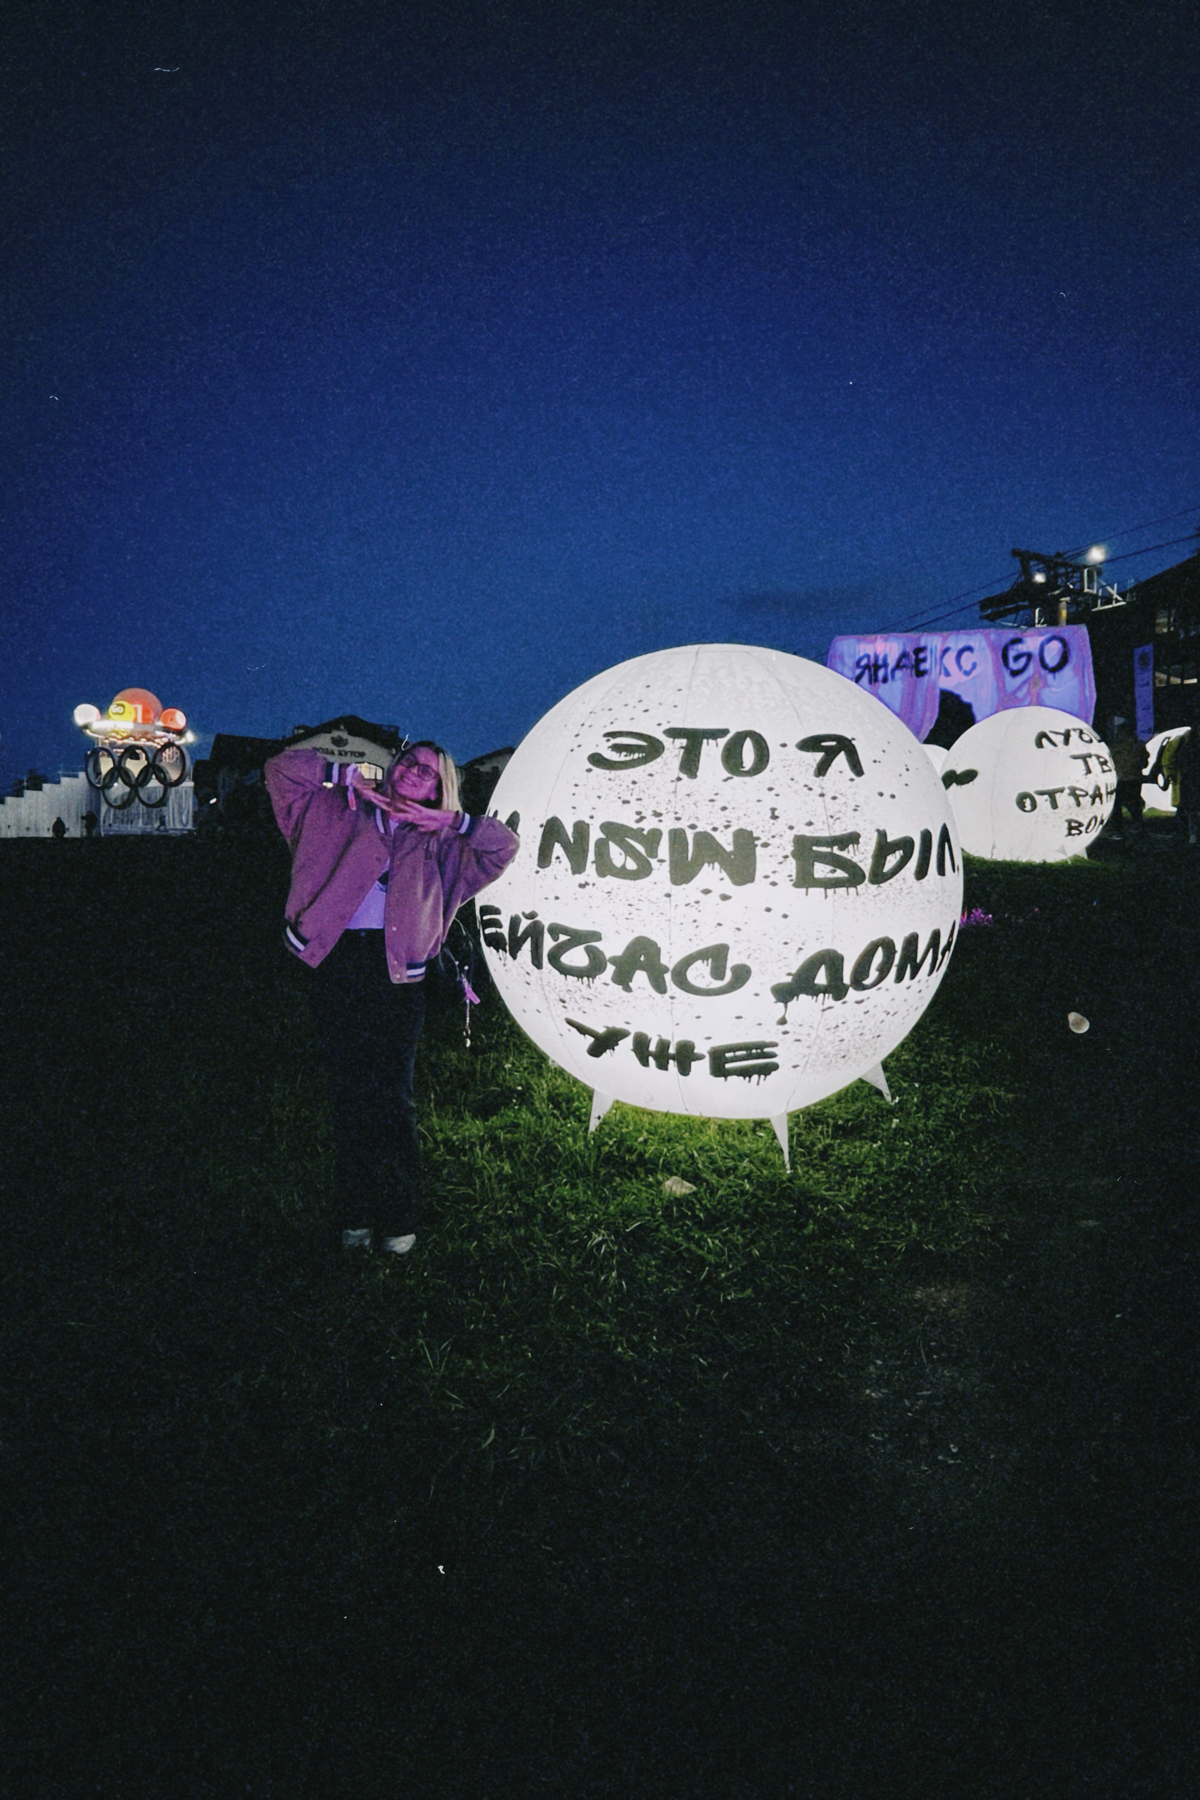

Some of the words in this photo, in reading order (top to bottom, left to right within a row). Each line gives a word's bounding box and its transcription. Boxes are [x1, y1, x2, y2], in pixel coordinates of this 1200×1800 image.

[1001, 635, 1069, 677] GO
[588, 727, 770, 779] ЭТО
[796, 733, 865, 778] Я
[792, 822, 957, 891] БЫЛ
[478, 904, 752, 997] ЕЙЧАС
[564, 1017, 780, 1080] УЖЕ
